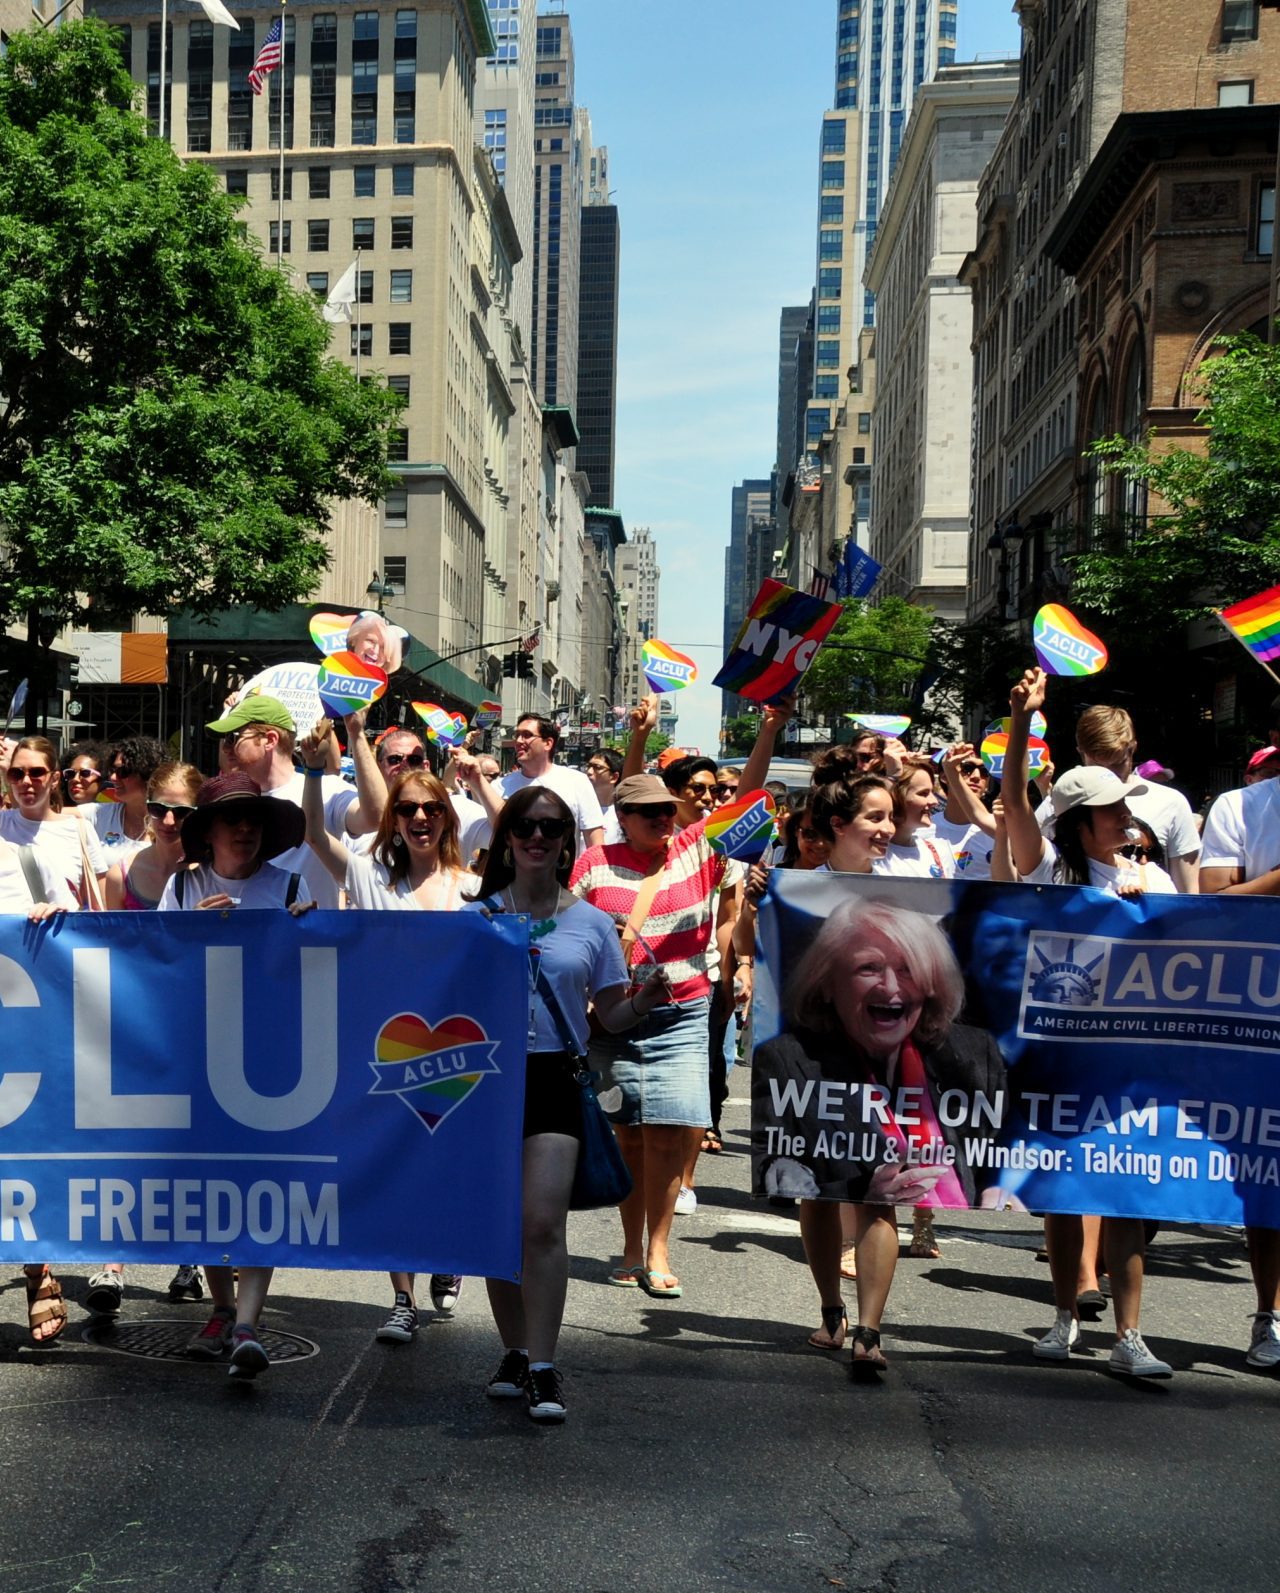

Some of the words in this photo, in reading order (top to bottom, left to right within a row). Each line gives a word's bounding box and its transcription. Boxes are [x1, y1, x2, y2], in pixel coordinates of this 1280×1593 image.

[331, 634, 348, 649] AC
[738, 617, 818, 673] NYC
[1048, 631, 1092, 662] ACLU
[267, 671, 318, 690] NYCL
[652, 660, 687, 678] ACLU
[277, 690, 316, 699] PROTECTIN
[330, 680, 368, 695] ACLU
[729, 810, 763, 847] ACLU
[1113, 952, 1280, 1006] ACLU
[1034, 1016, 1109, 1031] AMERICAN
[1113, 1019, 1149, 1033] CIVIL
[1153, 1021, 1230, 1037] LIBERTIES
[1234, 1026, 1280, 1041] UNION
[404, 1052, 467, 1083] ACLU
[769, 1078, 924, 1126] WE'RE
[938, 1091, 1004, 1129] ON
[1022, 1093, 1159, 1137] TEAM
[1176, 1099, 1280, 1148] EDIE
[765, 1127, 805, 1156] The
[813, 1130, 877, 1163] ACLU
[884, 1140, 901, 1163] &
[907, 1136, 955, 1167] Edie
[966, 1140, 1073, 1173] Windsor:
[1080, 1142, 1160, 1184] Taking
[1169, 1155, 1197, 1180] on
[68, 1178, 340, 1246] FREEDOM
